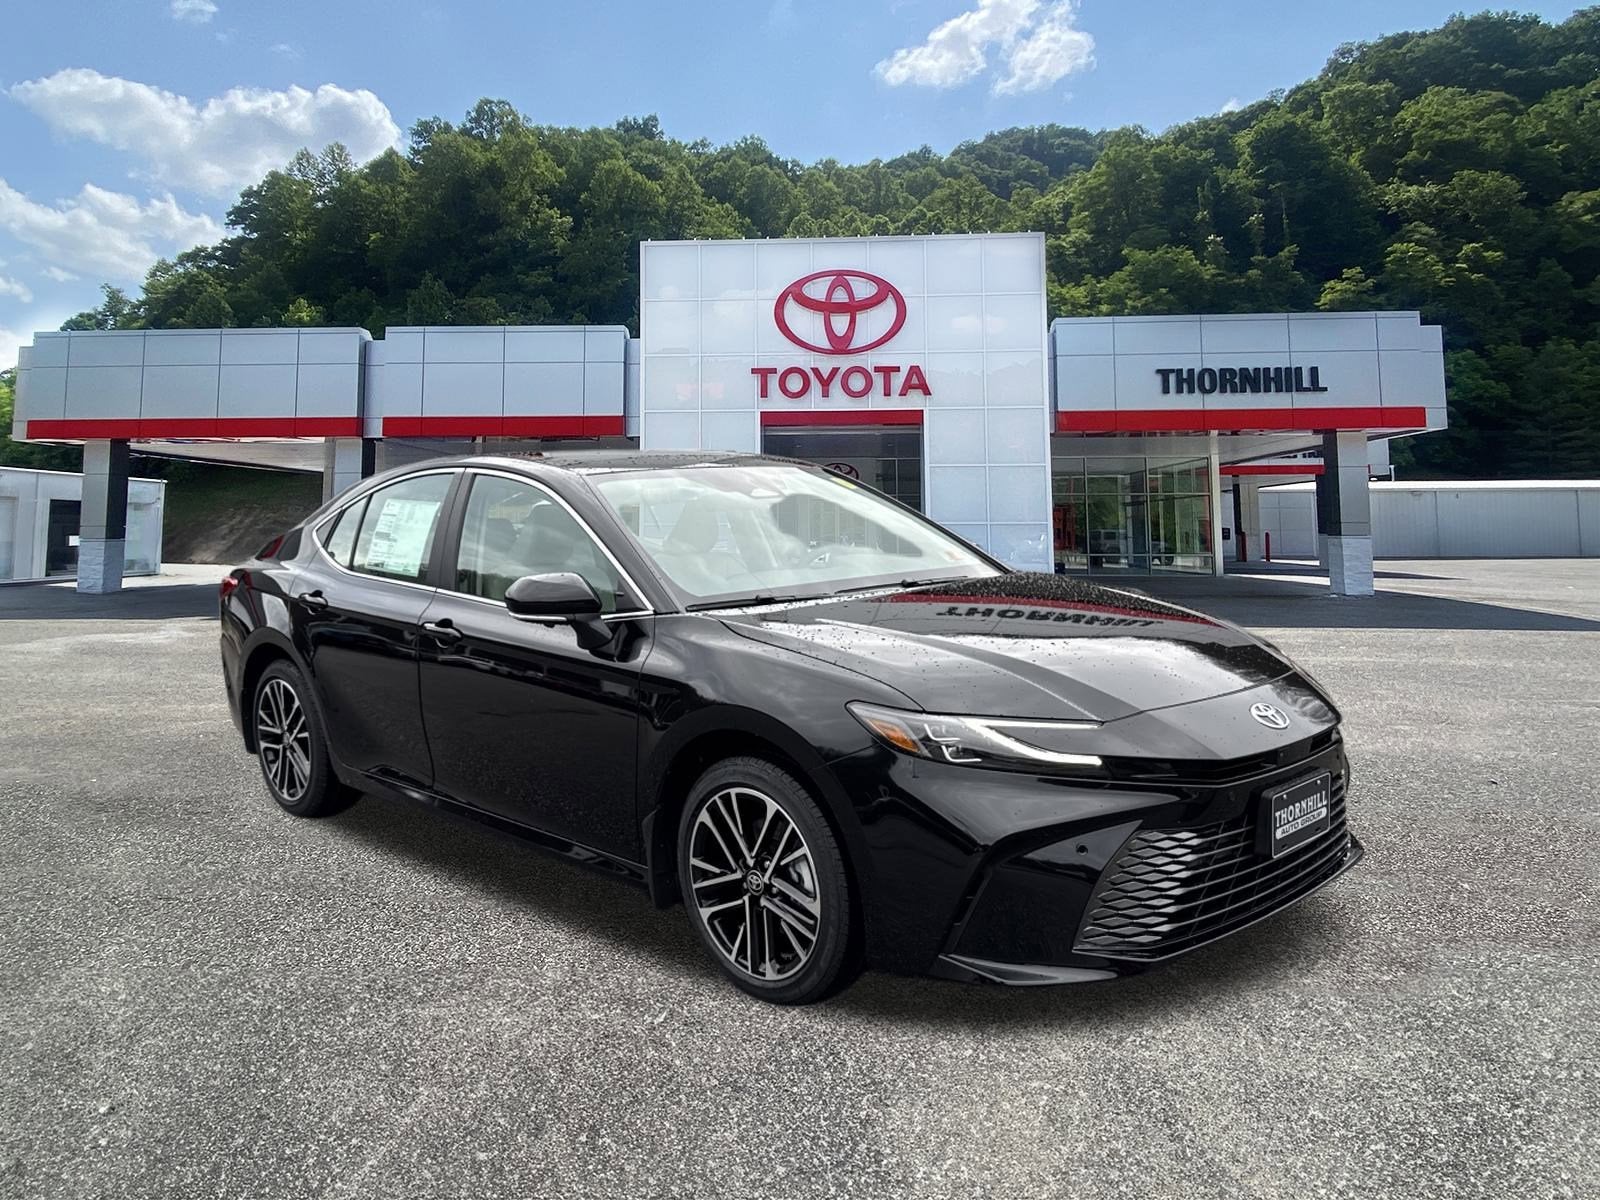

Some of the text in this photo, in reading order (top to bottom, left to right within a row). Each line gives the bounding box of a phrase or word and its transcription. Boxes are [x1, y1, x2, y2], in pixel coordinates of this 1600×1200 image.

[751, 365, 932, 398] TOYOTA
[1155, 366, 1328, 394] THORNHILL
[1275, 791, 1327, 827] THORNHILL
[1281, 822, 1299, 834] AUTO
